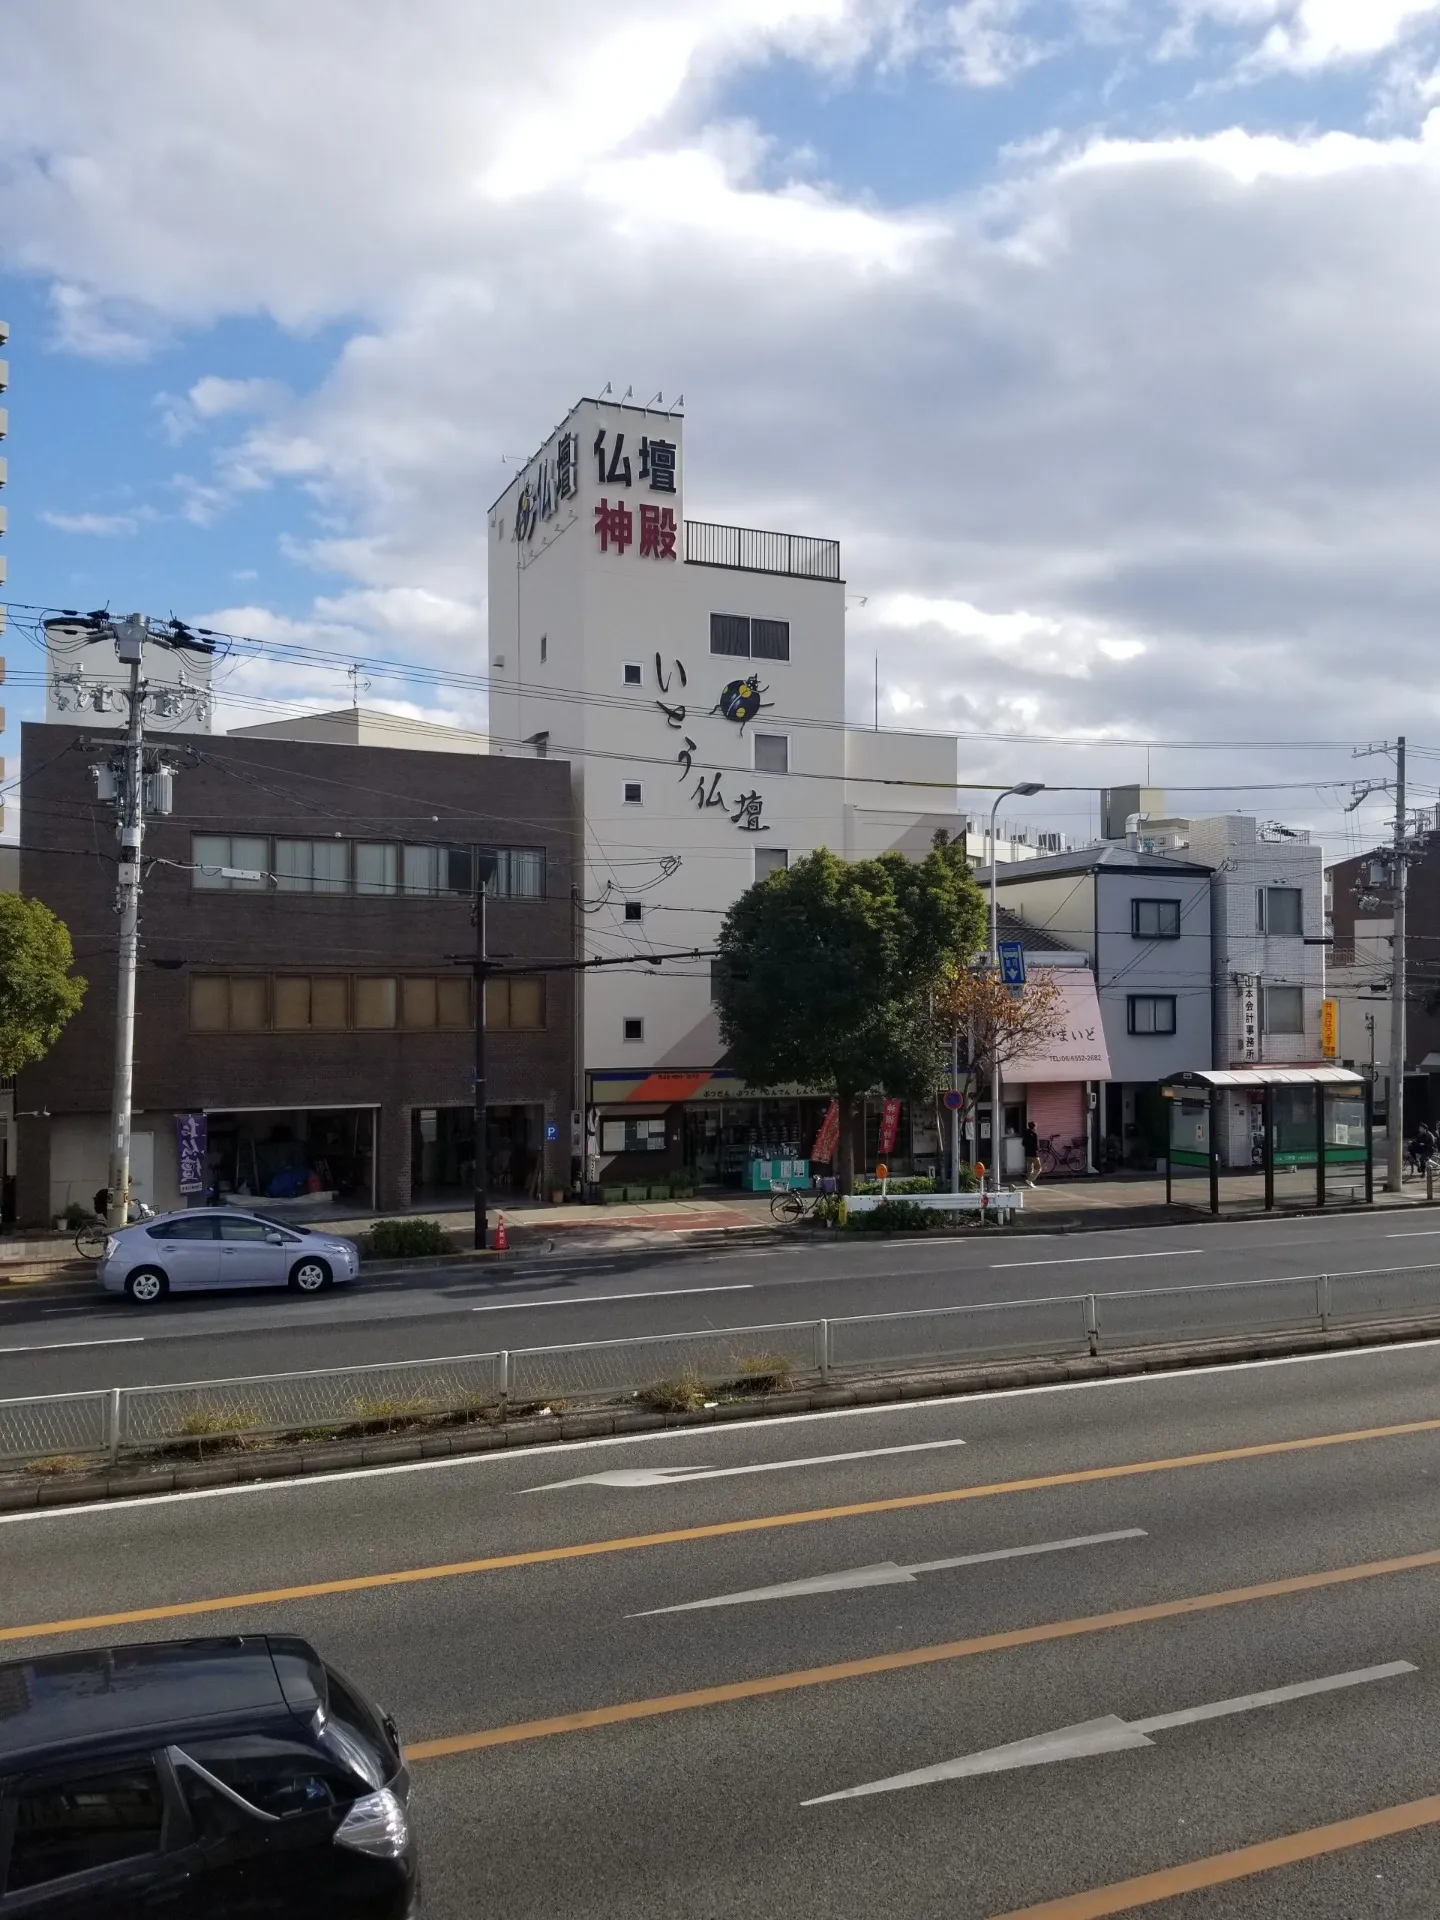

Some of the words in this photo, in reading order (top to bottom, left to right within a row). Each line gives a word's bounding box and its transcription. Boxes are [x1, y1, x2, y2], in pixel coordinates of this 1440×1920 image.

[593, 428, 678, 494] 仏壇
[594, 497, 678, 561] 神殿
[547, 1126, 556, 1137] P
